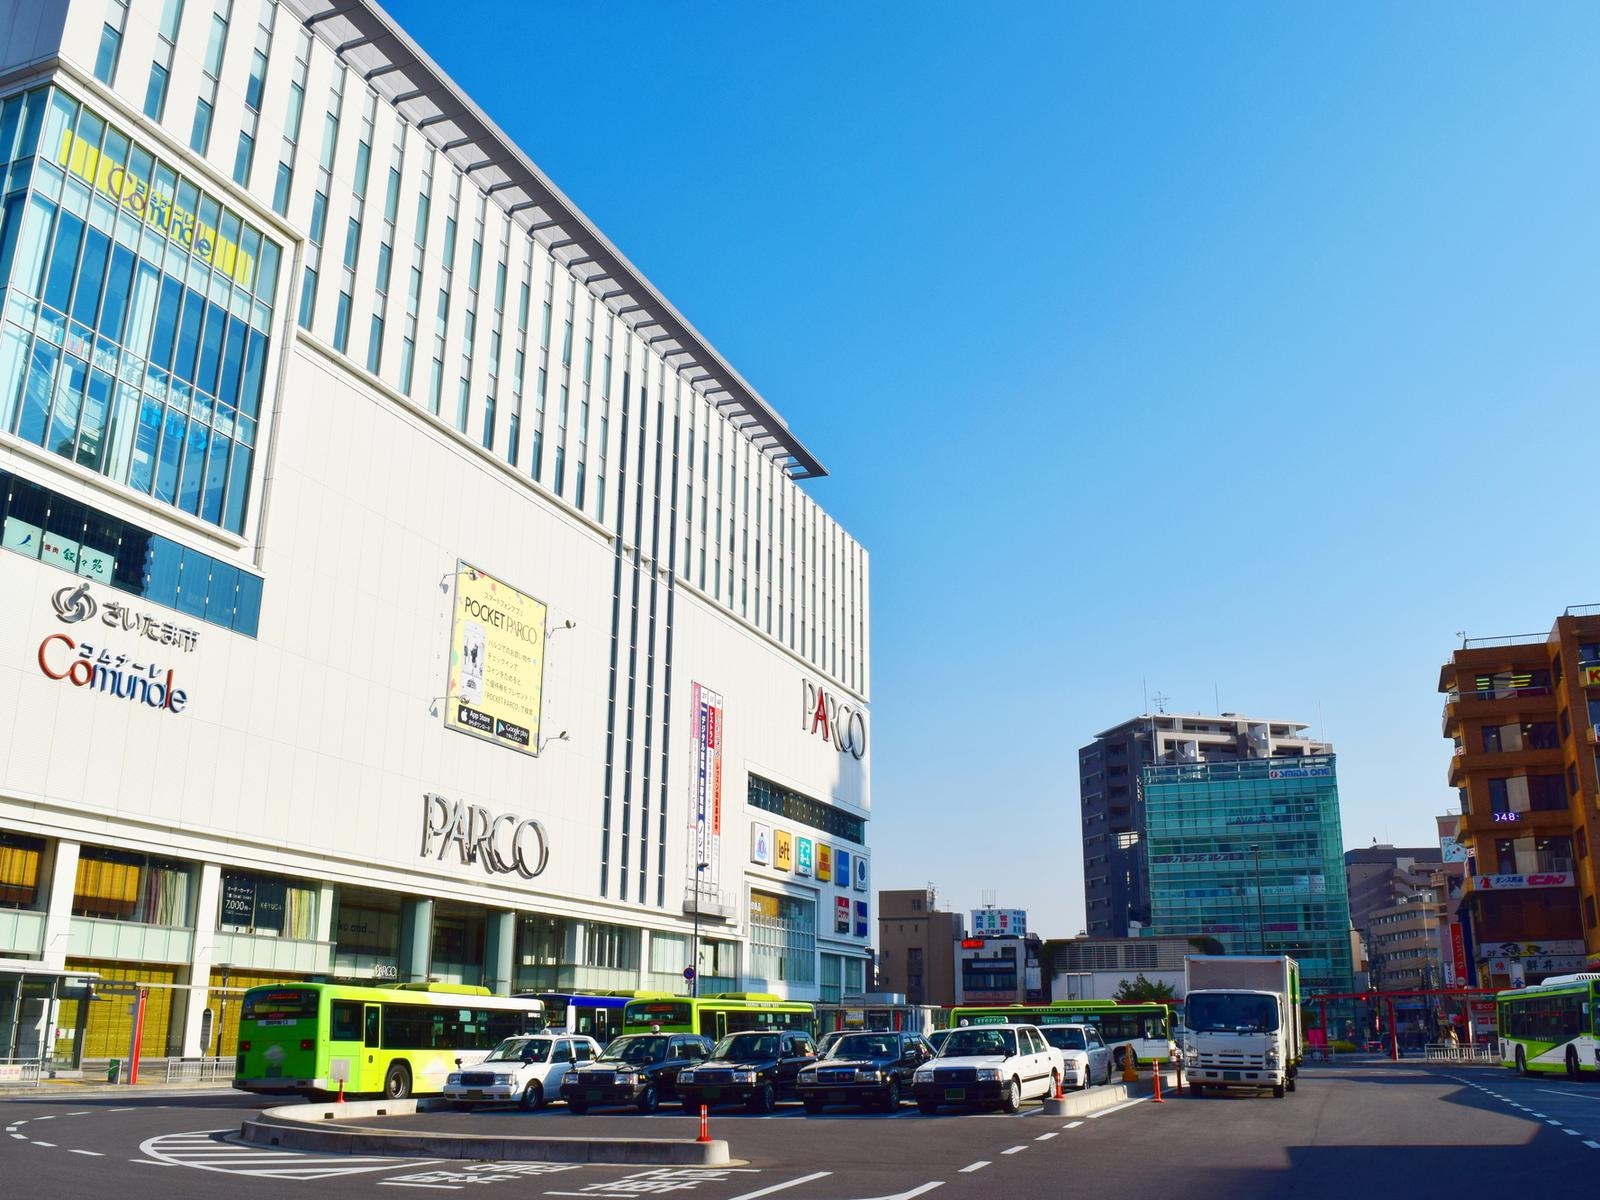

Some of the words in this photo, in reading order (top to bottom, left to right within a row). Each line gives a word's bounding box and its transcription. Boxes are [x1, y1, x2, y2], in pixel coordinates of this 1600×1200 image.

[102, 601, 201, 653] さいたま市
[465, 596, 505, 629] POCKET
[506, 616, 537, 645] PARCO
[38, 633, 188, 714] Comunale
[79, 642, 163, 678] コムナーレ
[470, 710, 479, 720] App
[480, 713, 490, 723] Store
[506, 724, 520, 736] Google
[801, 677, 866, 761] PARCO
[419, 792, 550, 880] PARCO
[779, 839, 790, 861] Loft
[1171, 854, 1225, 864] カラオケ
